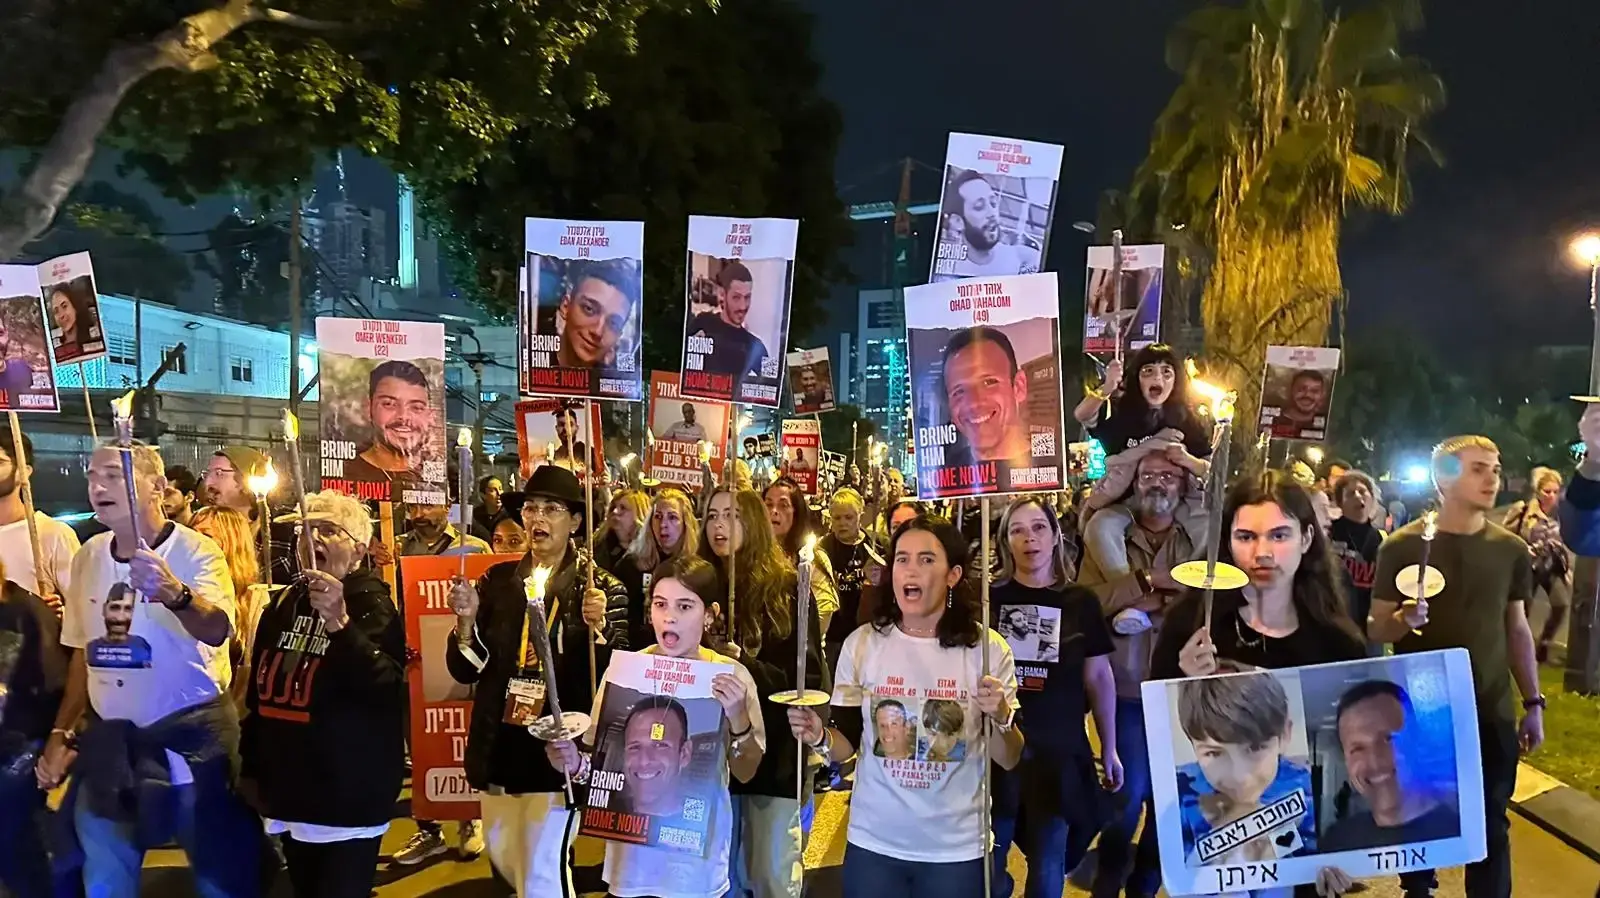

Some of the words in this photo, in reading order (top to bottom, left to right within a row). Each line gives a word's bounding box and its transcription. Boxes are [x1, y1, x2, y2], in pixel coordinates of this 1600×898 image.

[560, 236, 576, 246] EDAN
[576, 237, 610, 247] ALEXANDER
[578, 247, 590, 257] (19)
[937, 243, 968, 260] BRING
[936, 260, 955, 274] HIM
[984, 283, 1003, 295] אוהד
[950, 298, 971, 312] OHAD
[972, 296, 1011, 309] YAHALOMI
[973, 310, 989, 323] (49)
[355, 332, 374, 344] OMER
[375, 333, 408, 345] WENKERT
[531, 335, 561, 351] BRING
[687, 336, 714, 354] BRING
[374, 345, 389, 357] (22)
[531, 351, 550, 368] HIM
[686, 353, 704, 371] HIM
[531, 369, 560, 385] HOME
[561, 370, 589, 387] NOW!
[685, 370, 710, 388] HOME
[919, 424, 957, 447] BRING
[320, 440, 356, 460] BRING
[920, 446, 945, 467] HIM
[321, 458, 344, 478] HIM
[662, 453, 682, 467] שנים
[685, 455, 691, 467] 9
[922, 466, 957, 489] HOME
[960, 461, 997, 485] NOW!
[321, 479, 354, 497] HOME
[356, 481, 392, 501] NOW!
[644, 669, 662, 680] OHAD
[663, 672, 696, 685] YAHALOMI
[887, 676, 904, 685] OHAD
[1024, 666, 1048, 678] HANAN
[937, 679, 956, 688] EITAN
[907, 688, 917, 697] 49
[960, 690, 967, 699] 12
[425, 708, 466, 733] בבית
[883, 759, 947, 772] KIDNAPPED
[591, 770, 625, 791] BRING
[902, 771, 941, 780] HAMAS-ISIS
[587, 788, 610, 808] HIM
[1253, 796, 1302, 829] מחכה
[584, 808, 616, 830] HOME
[616, 813, 650, 835] NOW!
[1202, 817, 1248, 855] לאבא
[1368, 847, 1427, 871] אוהד
[1216, 862, 1279, 892] איתן
